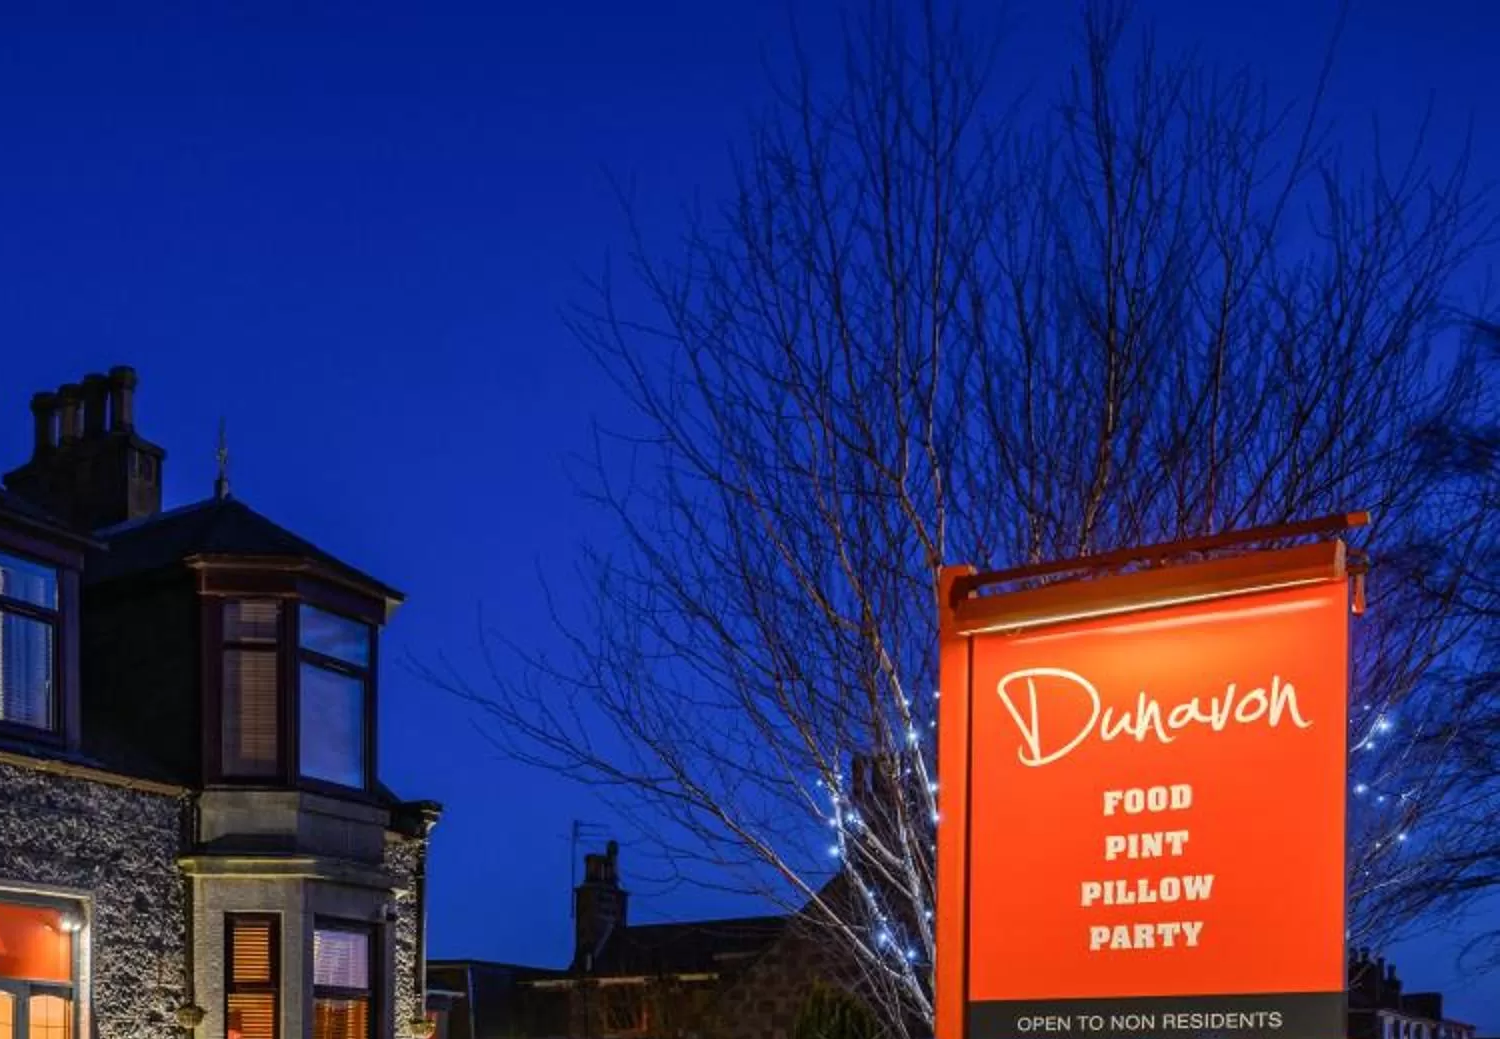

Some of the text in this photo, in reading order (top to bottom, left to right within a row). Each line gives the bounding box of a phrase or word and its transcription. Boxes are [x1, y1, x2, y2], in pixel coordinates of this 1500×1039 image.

[997, 667, 1313, 767] Dunavon
[1103, 784, 1193, 816] FOOD
[1105, 830, 1189, 861] PINT
[1081, 874, 1215, 907] PILLOW
[1090, 921, 1203, 951] PARTY
[1017, 1011, 1283, 1032] OPEN TO NON RESIDENTS
